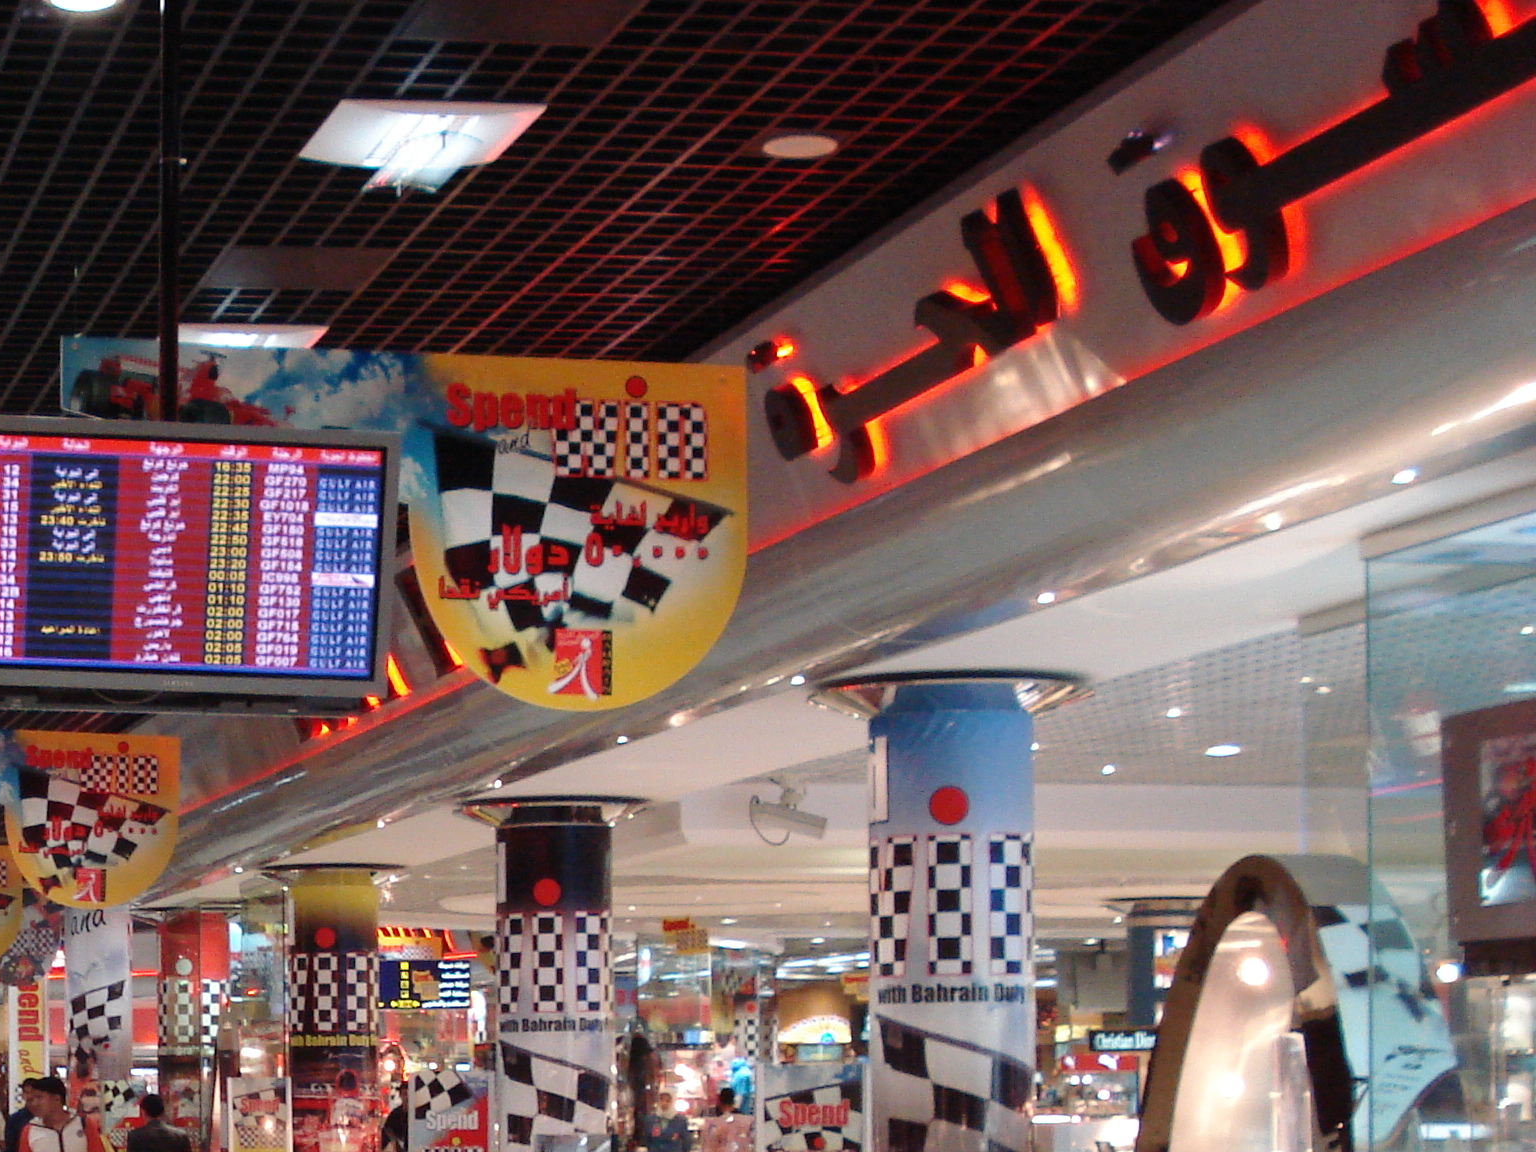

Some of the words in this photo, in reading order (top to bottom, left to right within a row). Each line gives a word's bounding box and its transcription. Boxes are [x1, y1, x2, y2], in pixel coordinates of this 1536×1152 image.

[446, 382, 577, 432] Spend
[4, 464, 19, 475] 12
[215, 474, 251, 484] 22:00
[0, 561, 16, 572] 17
[209, 582, 245, 593] 01:10
[208, 595, 244, 605] 01:10
[911, 982, 989, 1003] Bahrain
[522, 1017, 576, 1032] Bahrain
[425, 1109, 479, 1131] Spend
[778, 1098, 850, 1128] Spend
